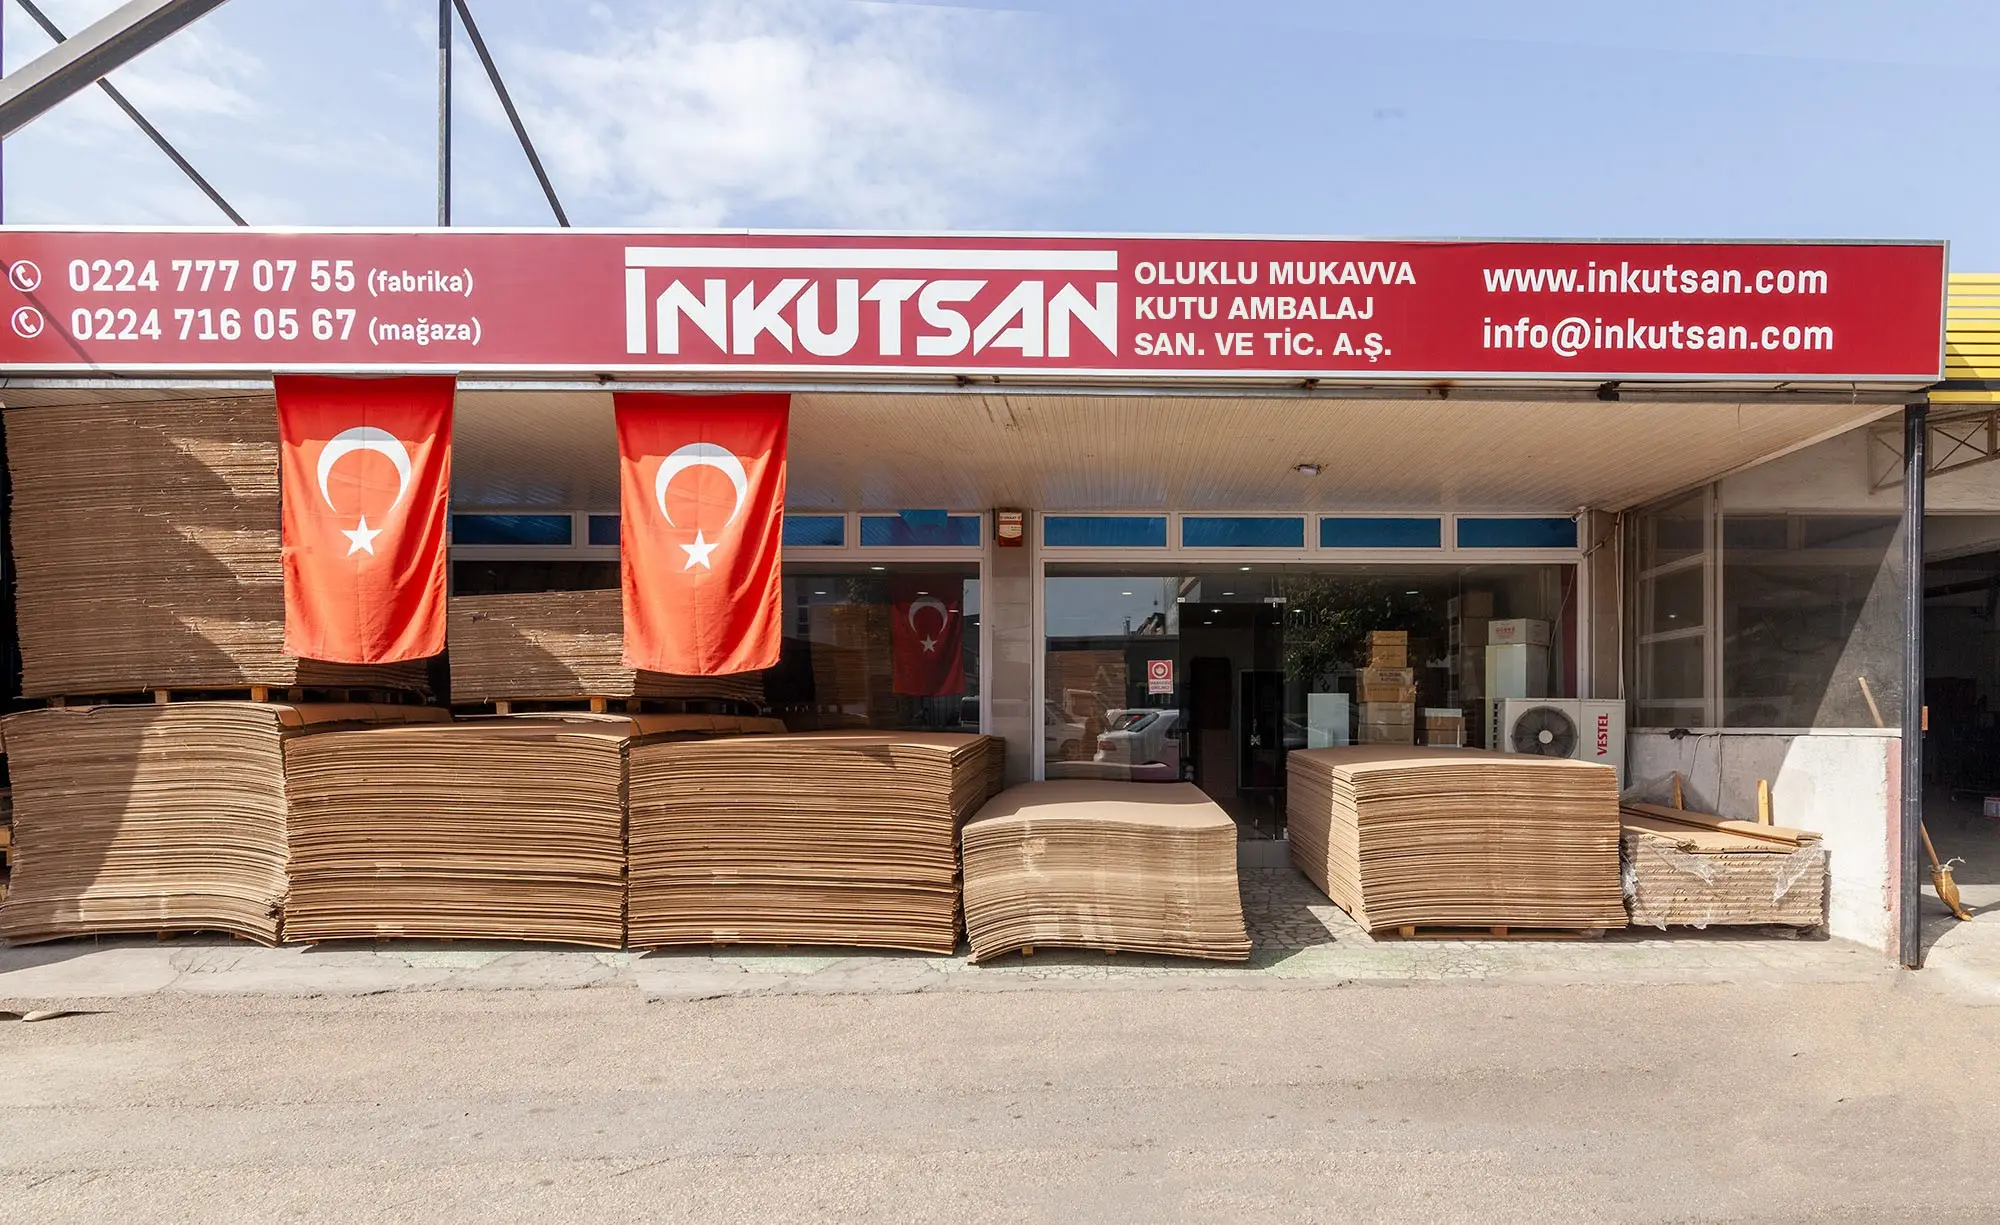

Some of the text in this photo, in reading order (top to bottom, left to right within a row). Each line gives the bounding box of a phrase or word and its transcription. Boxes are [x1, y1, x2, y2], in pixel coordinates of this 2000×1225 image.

[69, 260, 473, 297] 0224 777 07 55 (fabrika)
[1135, 262, 1416, 284] OLUKLU MUKAVVA
[1483, 262, 1828, 294] www.inkutsan.com
[1136, 297, 1372, 319] KUTU AMBALAJ
[72, 308, 482, 346] 0224 716 05 67 (mağaza)
[1483, 317, 1833, 357] info@inkutsan.com
[1135, 328, 1390, 362] SAN. VE TİC. A.Ş.
[1597, 713, 1609, 756] VESTEL
